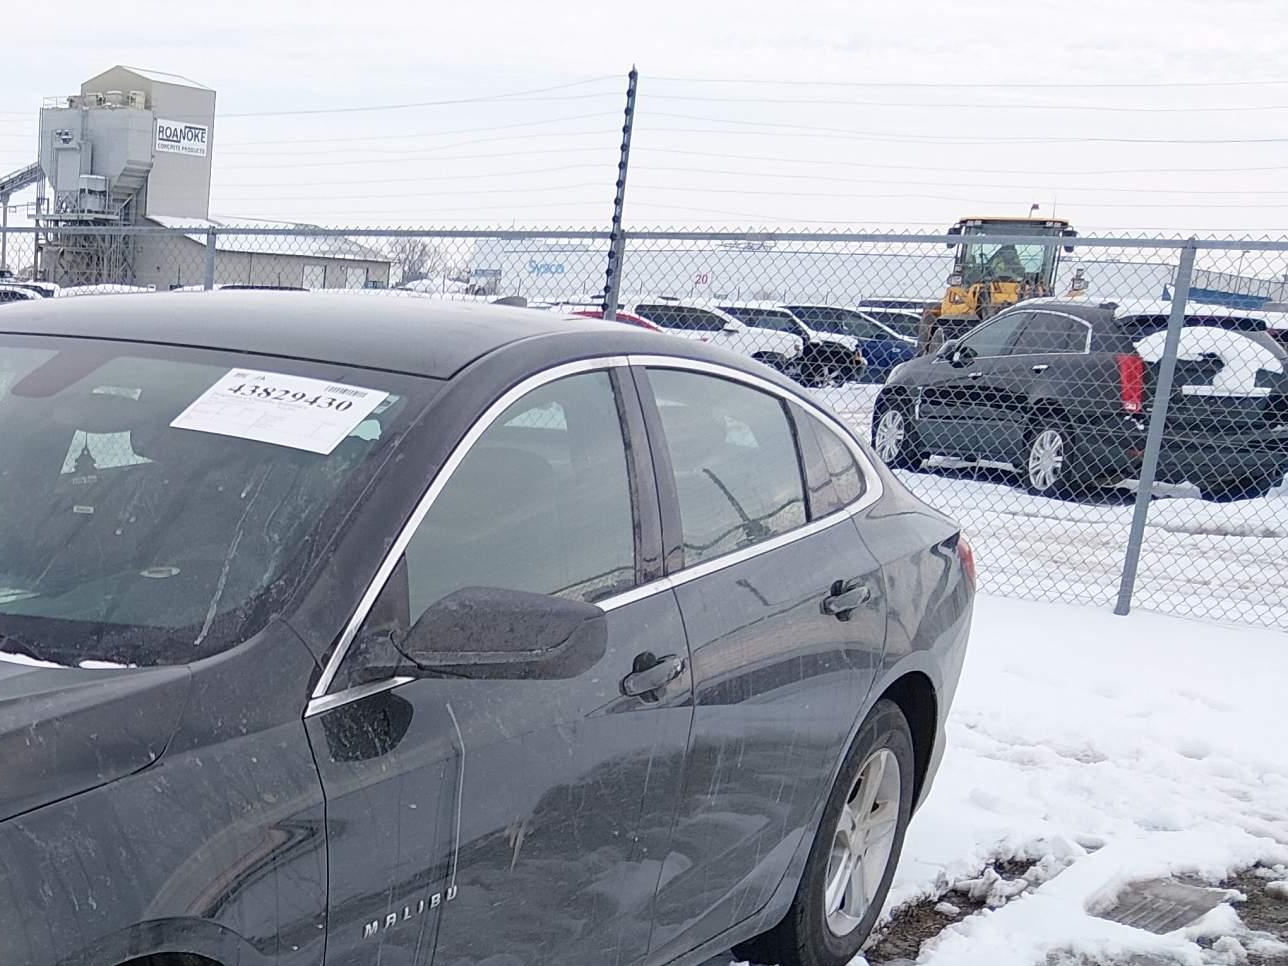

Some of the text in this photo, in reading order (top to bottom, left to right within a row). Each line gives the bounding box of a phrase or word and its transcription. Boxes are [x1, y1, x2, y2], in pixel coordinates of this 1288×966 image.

[158, 125, 207, 143] ROANOKE
[695, 274, 708, 285] 20
[228, 383, 353, 412] 43829430
[363, 885, 458, 939] MALIBU
